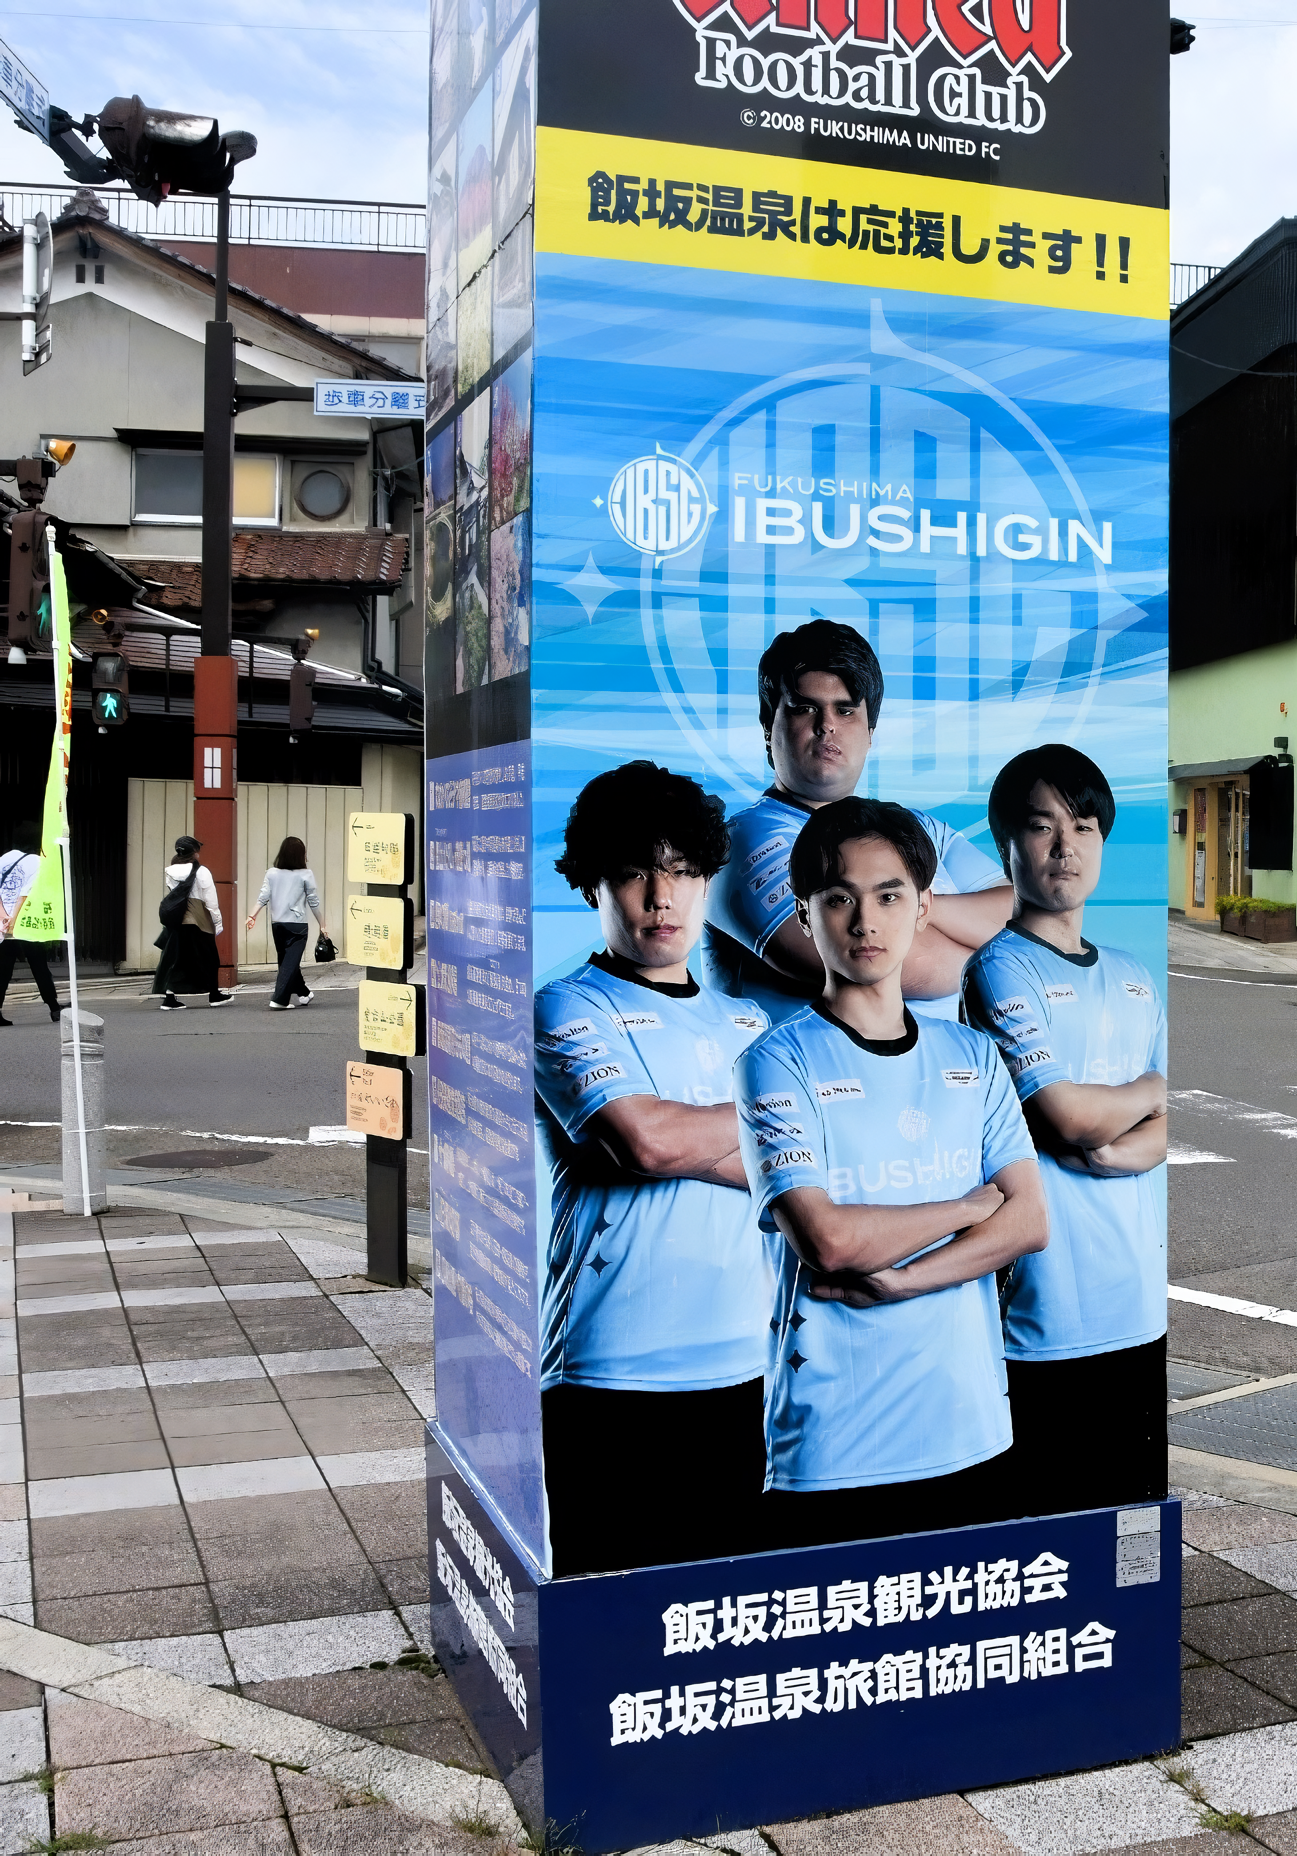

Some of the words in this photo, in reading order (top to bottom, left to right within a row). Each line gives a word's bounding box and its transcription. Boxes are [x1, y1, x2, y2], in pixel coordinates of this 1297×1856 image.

[696, 30, 919, 114] Football
[928, 66, 1046, 133] Club
[760, 110, 804, 132] 2008
[810, 117, 911, 148] FUKUSHIMA
[916, 132, 976, 156] UNITED
[980, 141, 1001, 160] FC
[734, 472, 913, 502] FUKUSHIMA
[733, 496, 1112, 565] IBUSHIGIN
[584, 1065, 621, 1088] ZION
[773, 1149, 813, 1168] ZION
[661, 1551, 1069, 1656] 飯坂温泉観光協会
[608, 1621, 1116, 1747] 飯坂温泉旅館協同組合
